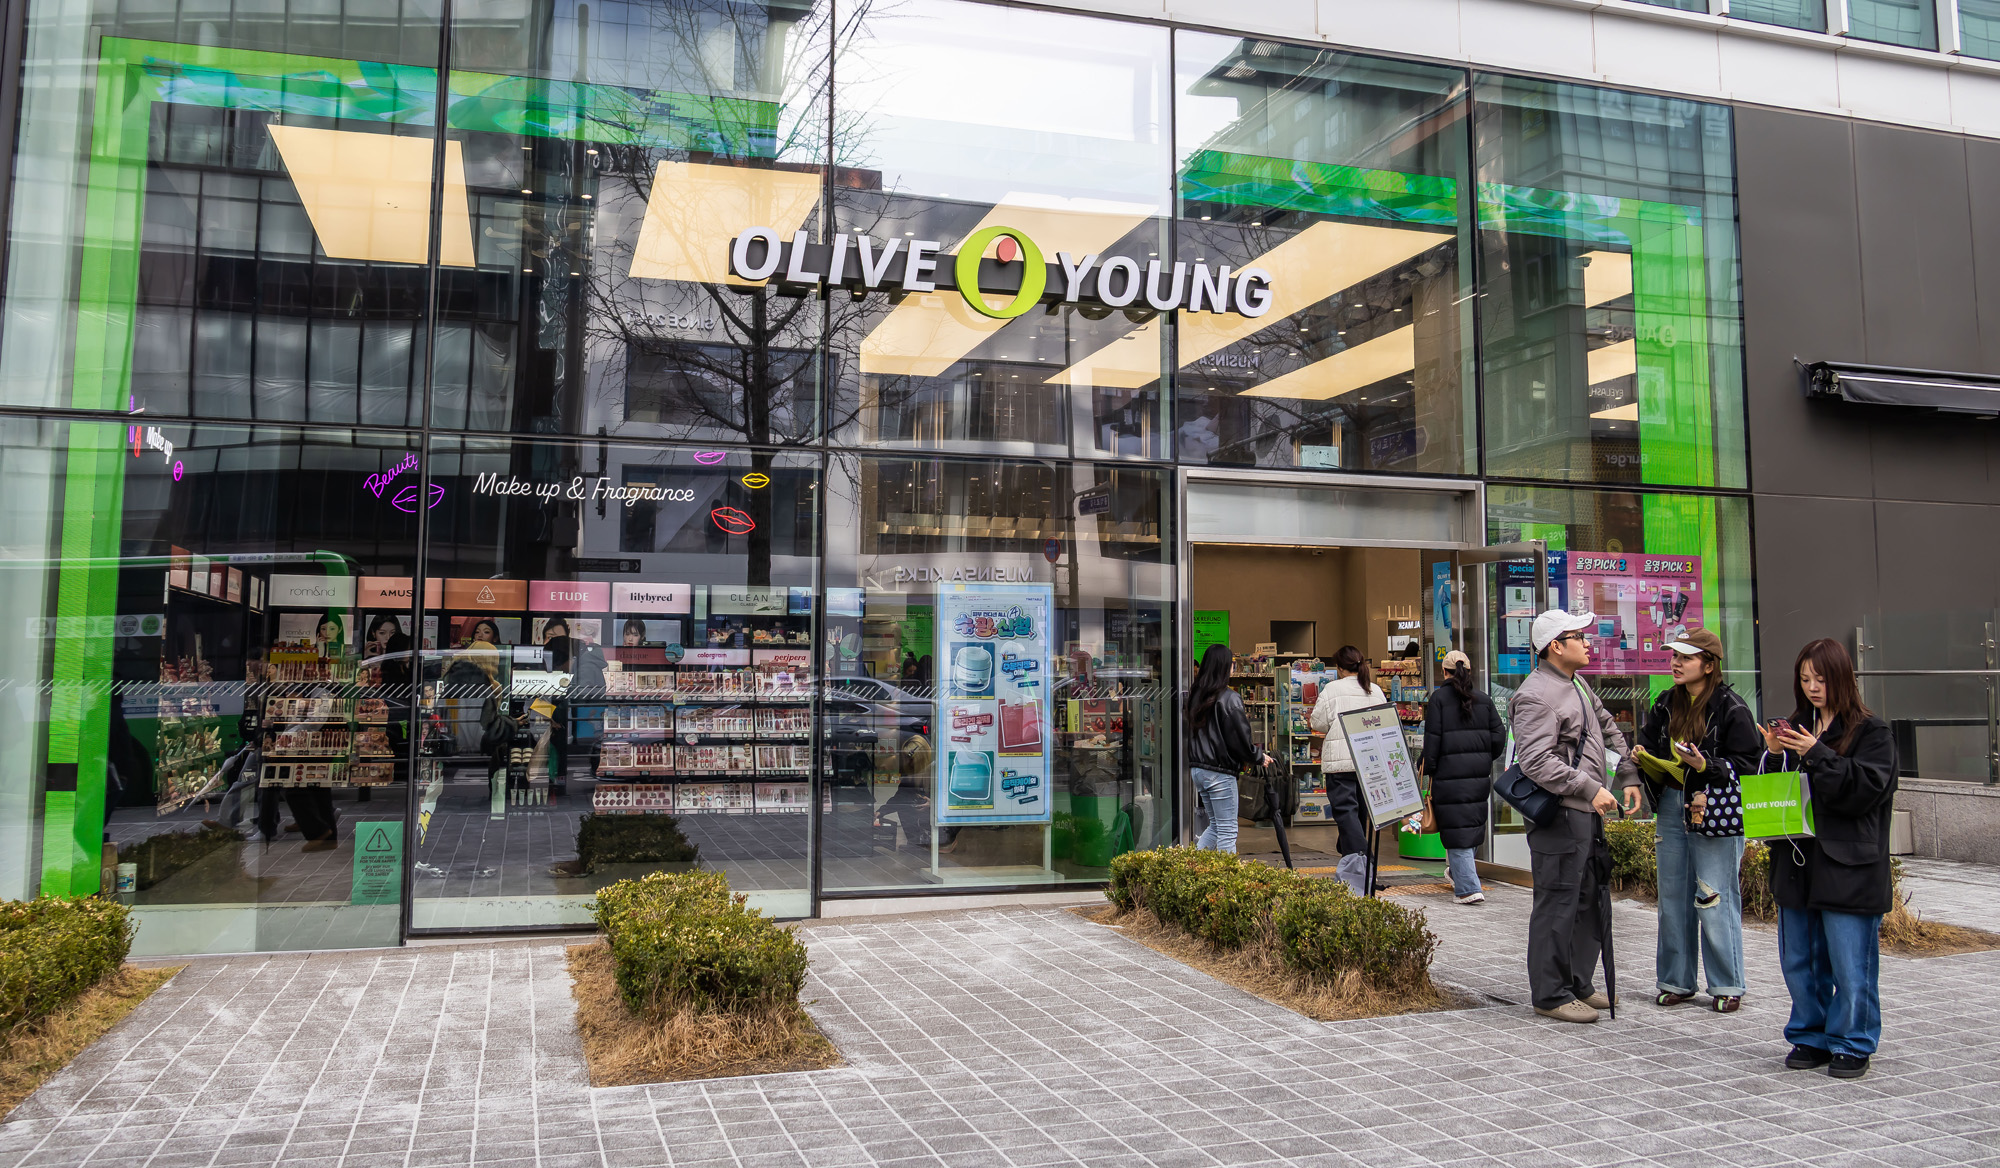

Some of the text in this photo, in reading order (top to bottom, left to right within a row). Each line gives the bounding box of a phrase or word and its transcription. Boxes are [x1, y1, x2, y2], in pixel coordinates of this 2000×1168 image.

[731, 226, 942, 293] OLIVE
[1057, 251, 1274, 318] YOUNG
[363, 452, 418, 498] Beauty
[473, 472, 695, 507] Make up & Fragrance
[1508, 564, 1534, 574] Special
[1576, 557, 1626, 571] 올영 PICK 3
[1644, 560, 1693, 573] 올영 PICK 3
[289, 586, 336, 597] rom&nd
[380, 589, 413, 597] AMUS
[550, 591, 589, 601] ETUDE
[630, 593, 673, 603] lilybyred
[730, 594, 769, 602] CLEAN
[697, 652, 727, 660] colorgram
[774, 654, 806, 662] peripera
[1437, 647, 1446, 660] 25
[1769, 799, 1797, 808] YOUNG
